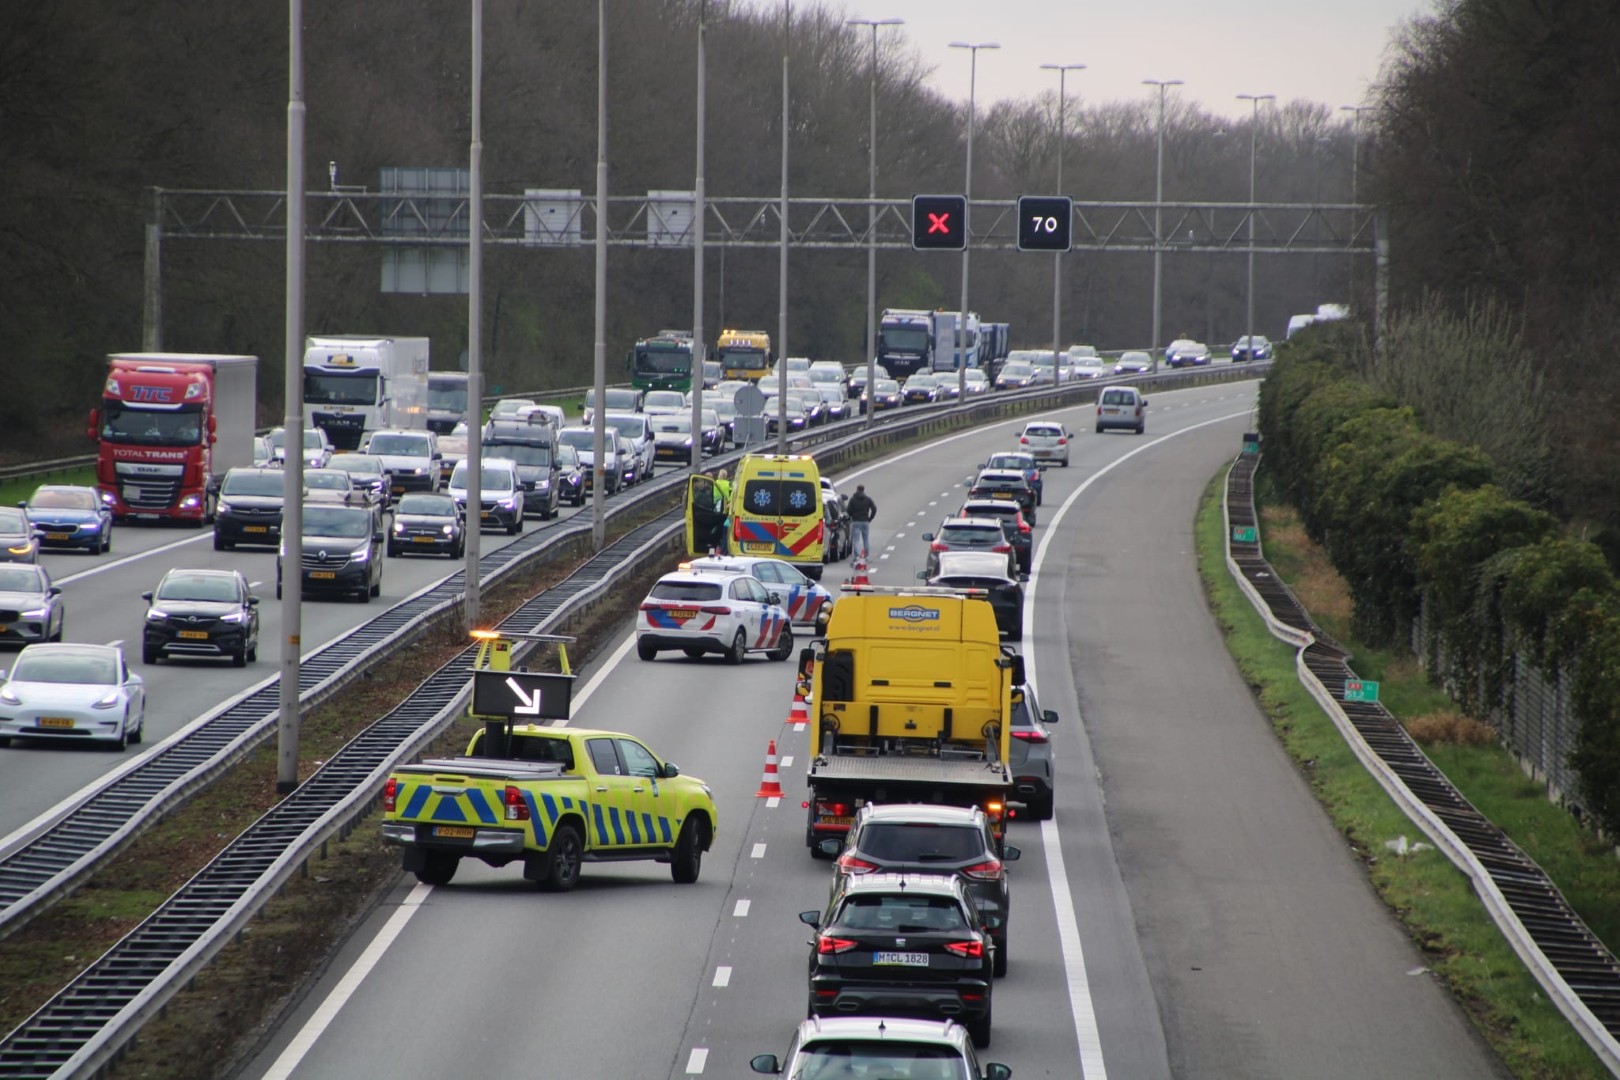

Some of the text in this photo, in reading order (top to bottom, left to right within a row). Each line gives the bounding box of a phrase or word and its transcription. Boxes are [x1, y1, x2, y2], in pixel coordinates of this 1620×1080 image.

[1033, 217, 1057, 232] 70
[113, 449, 143, 457] TOTAL
[890, 610, 938, 618] BERGNET
[905, 955, 928, 964] 1828
